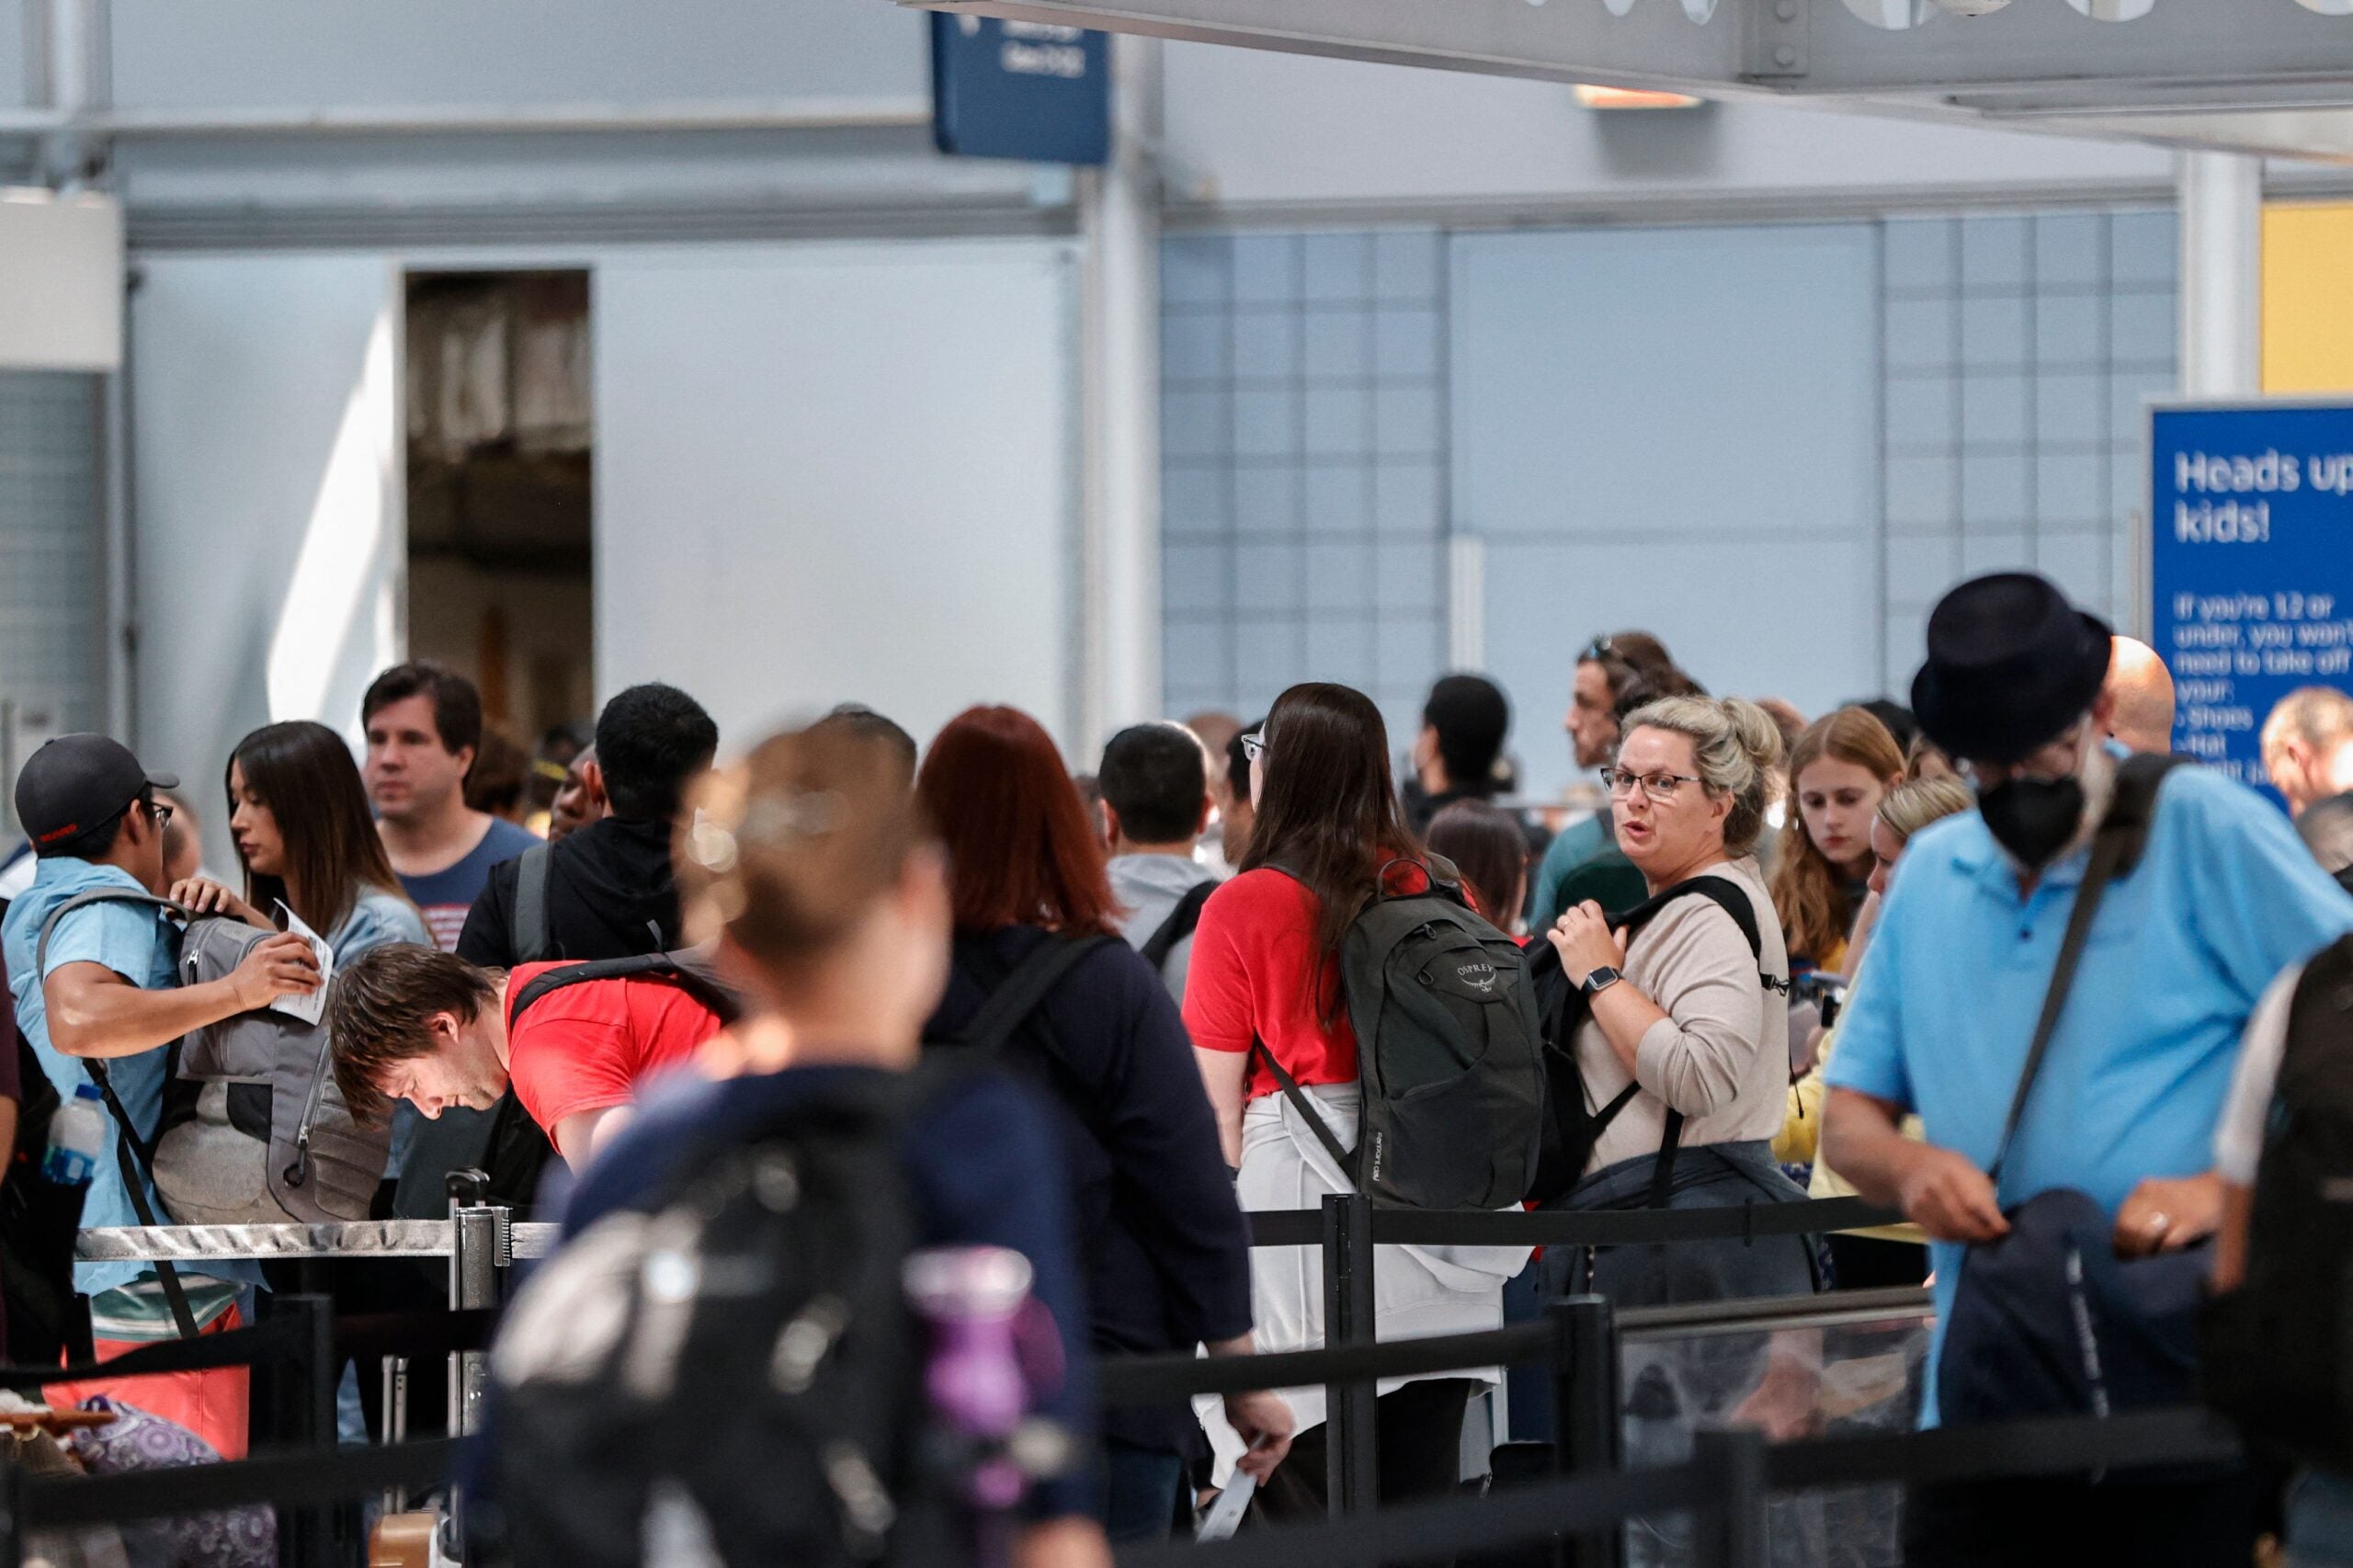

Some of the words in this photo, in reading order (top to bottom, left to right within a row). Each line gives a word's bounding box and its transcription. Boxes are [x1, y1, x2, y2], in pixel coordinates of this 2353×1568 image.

[2175, 448, 2301, 494] Heads
[2175, 499, 2270, 544] kids!
[2174, 593, 2195, 620] If
[2198, 593, 2269, 623] you're
[2275, 591, 2304, 620] 12
[2306, 594, 2335, 620] or
[2173, 622, 2245, 648] under,
[2249, 623, 2293, 651] you
[2173, 650, 2232, 676] need
[2234, 651, 2261, 676] to
[2262, 648, 2313, 676] take
[2315, 647, 2351, 676] off
[2188, 706, 2254, 731] Shoes
[1457, 963, 1494, 976] OSPREY
[1372, 1165, 1381, 1182] day
